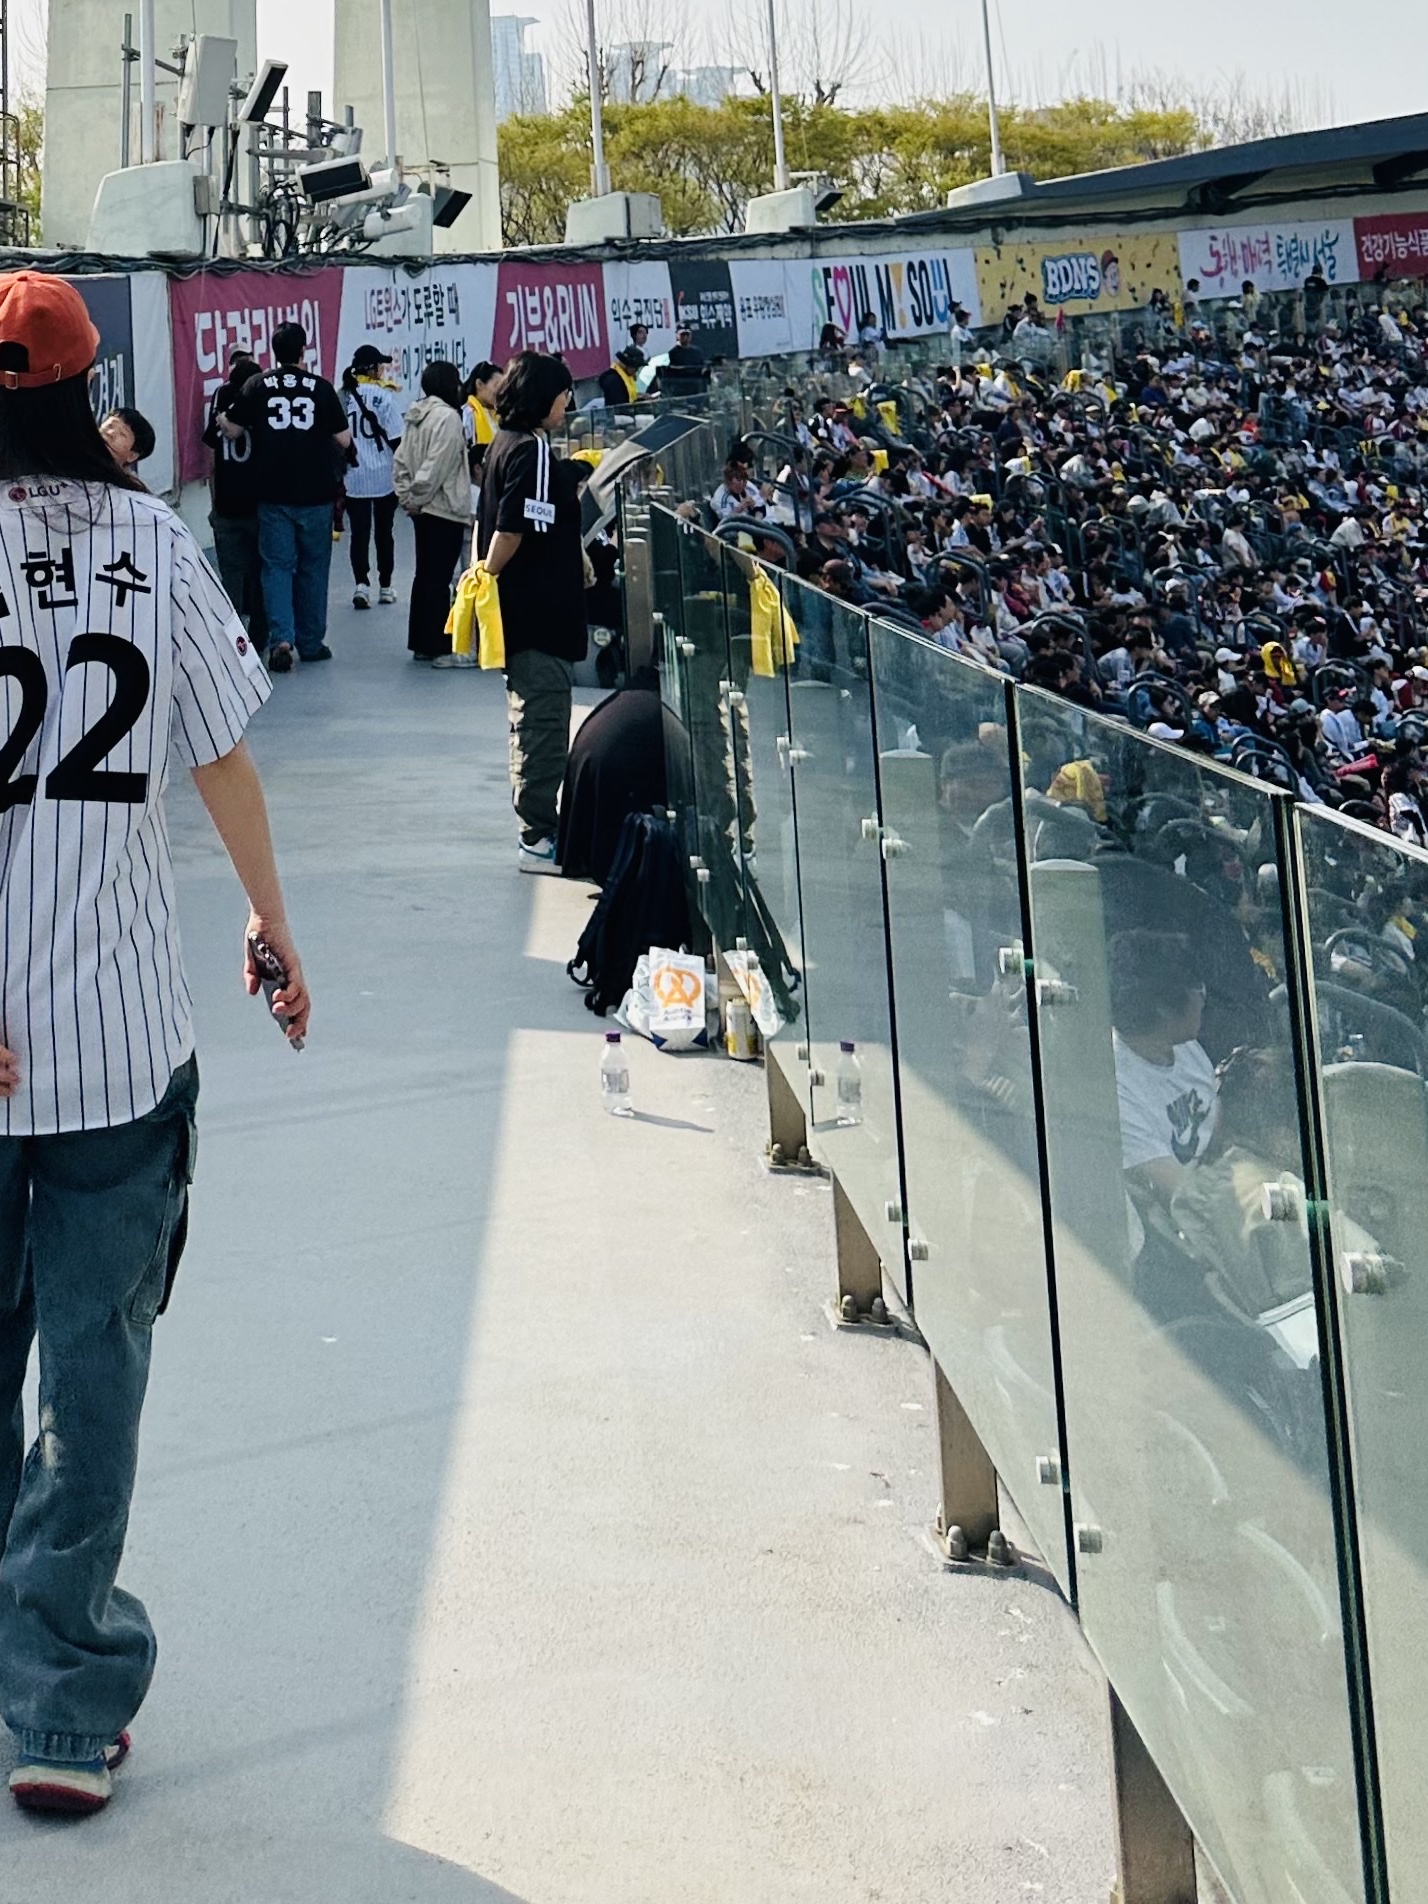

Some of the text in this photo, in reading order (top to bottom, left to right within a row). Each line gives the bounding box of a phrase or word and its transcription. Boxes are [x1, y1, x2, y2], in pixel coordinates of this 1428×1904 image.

[1045, 256, 1100, 295] BDNS
[365, 282, 460, 333] LG트윈스가 도루할 때
[506, 283, 600, 353] 기부&RUN
[267, 397, 315, 430] 33
[525, 504, 553, 517] SEOUL
